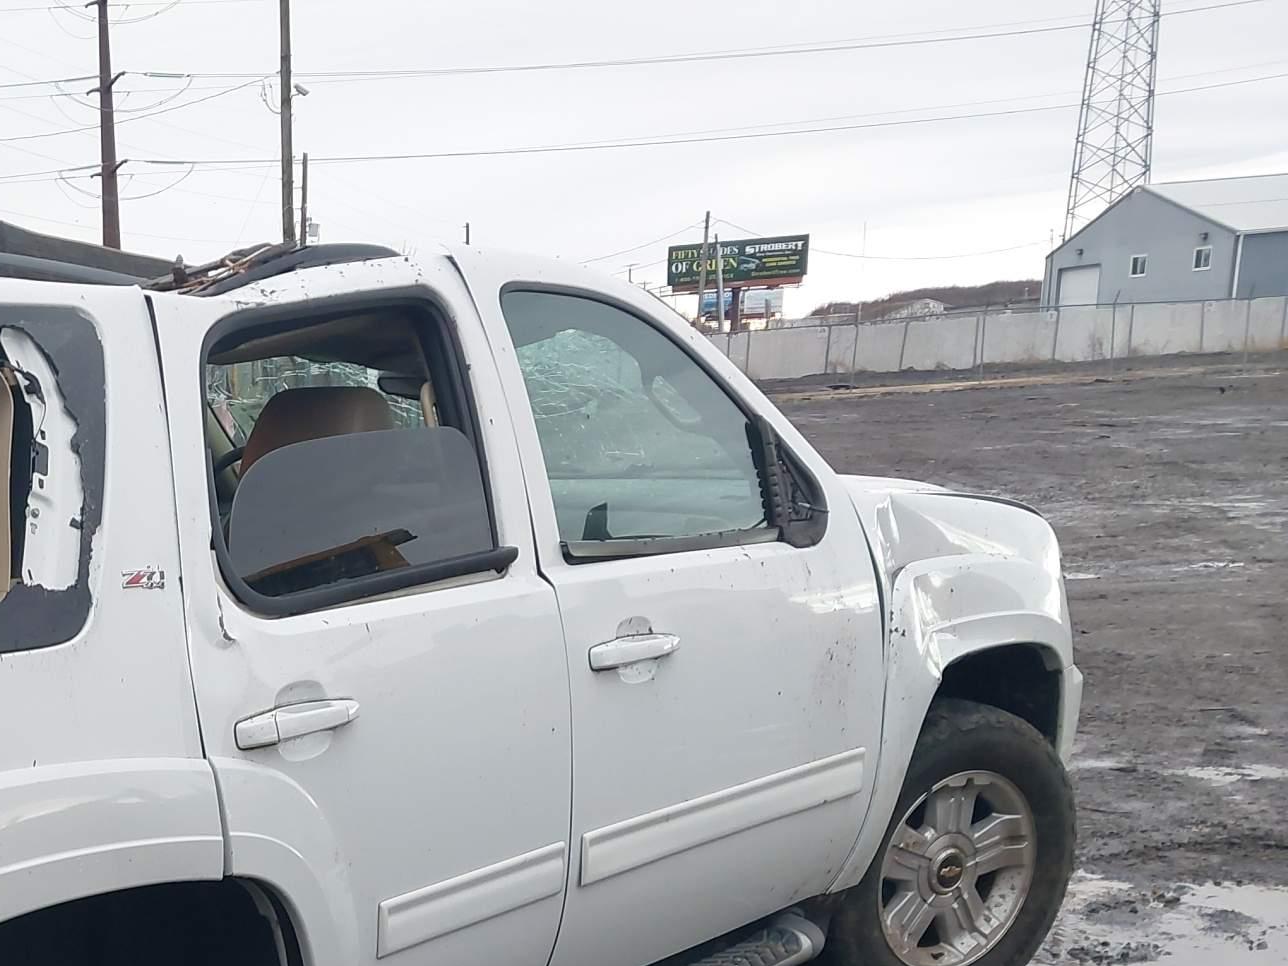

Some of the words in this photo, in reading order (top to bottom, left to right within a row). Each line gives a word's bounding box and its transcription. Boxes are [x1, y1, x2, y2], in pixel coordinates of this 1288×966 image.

[672, 249, 698, 259] FIFTY
[745, 241, 805, 255] STROBERT
[671, 261, 691, 273] OF
